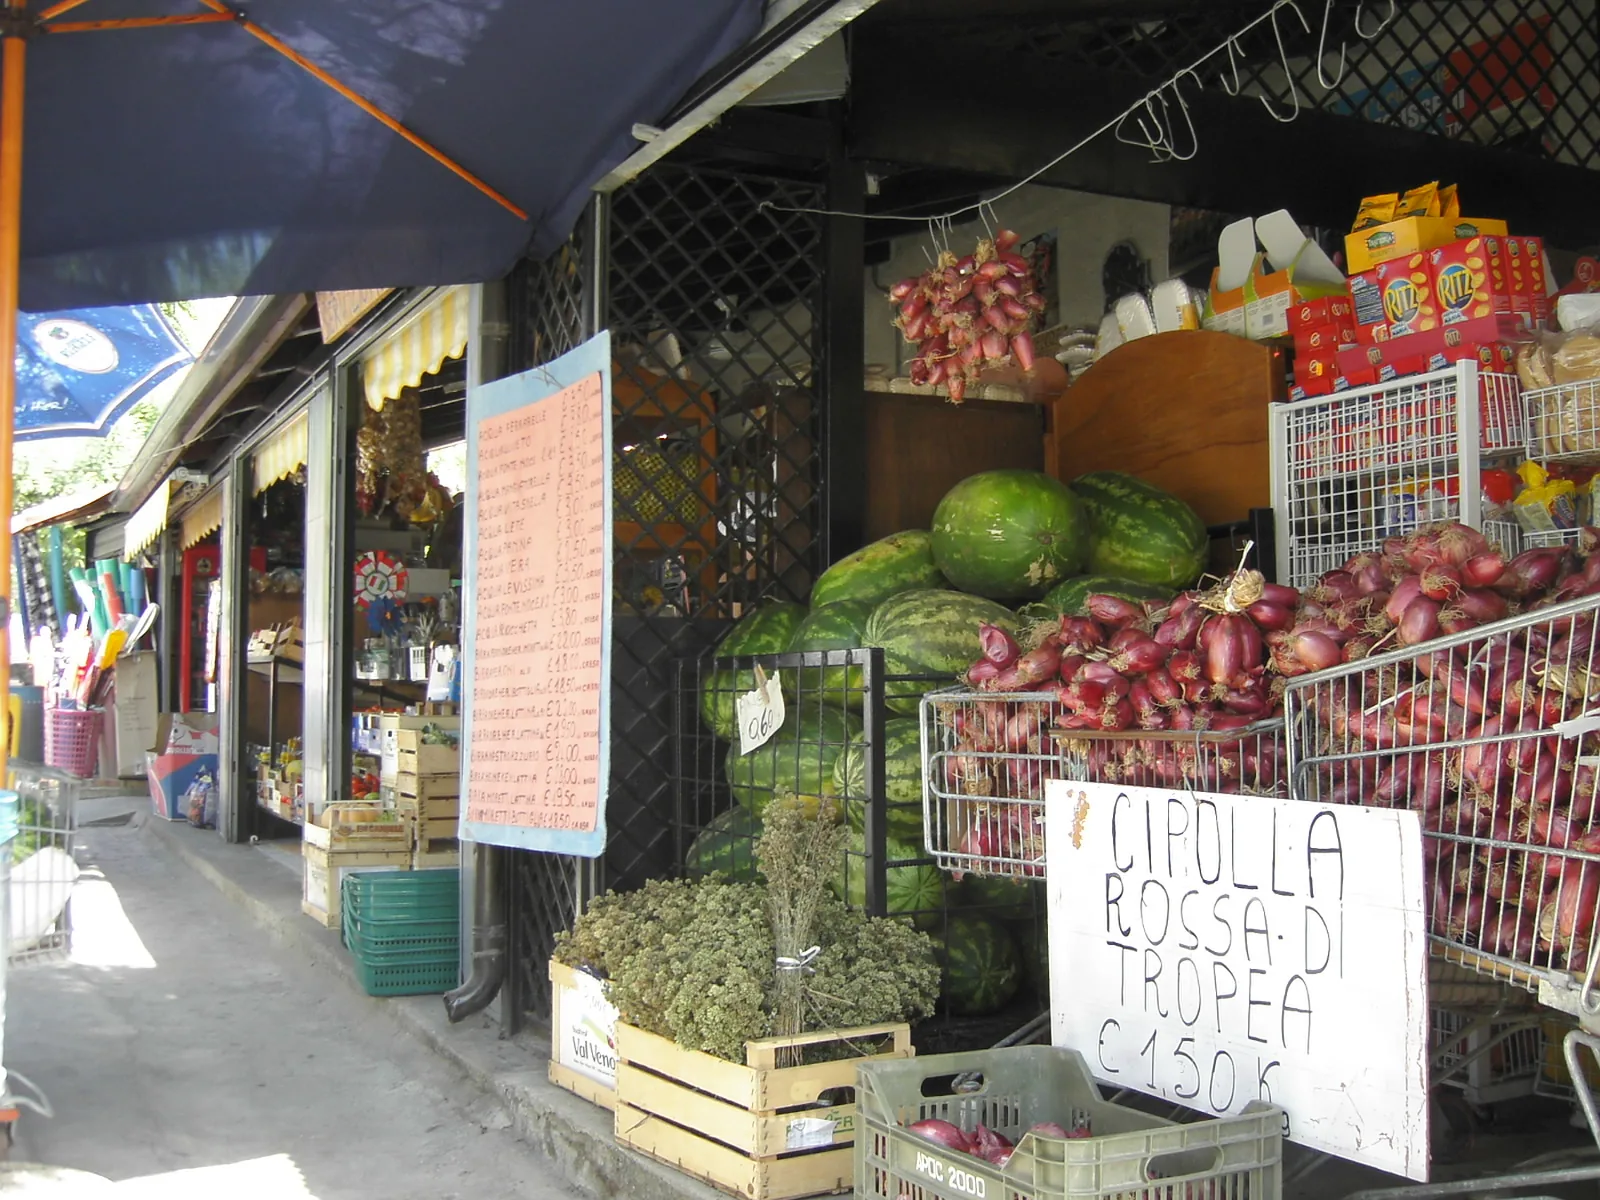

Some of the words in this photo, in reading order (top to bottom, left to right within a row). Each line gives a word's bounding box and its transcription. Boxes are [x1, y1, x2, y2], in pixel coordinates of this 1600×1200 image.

[1387, 284, 1418, 318] RITZ
[1440, 270, 1473, 304] RITZ
[1111, 792, 1344, 900] CIPOLLA
[1304, 903, 1343, 979] DI
[1106, 941, 1313, 1055] TROPEA
[572, 1036, 588, 1060] Val
[916, 1152, 943, 1181] APOC
[948, 1167, 986, 1198] 2000
